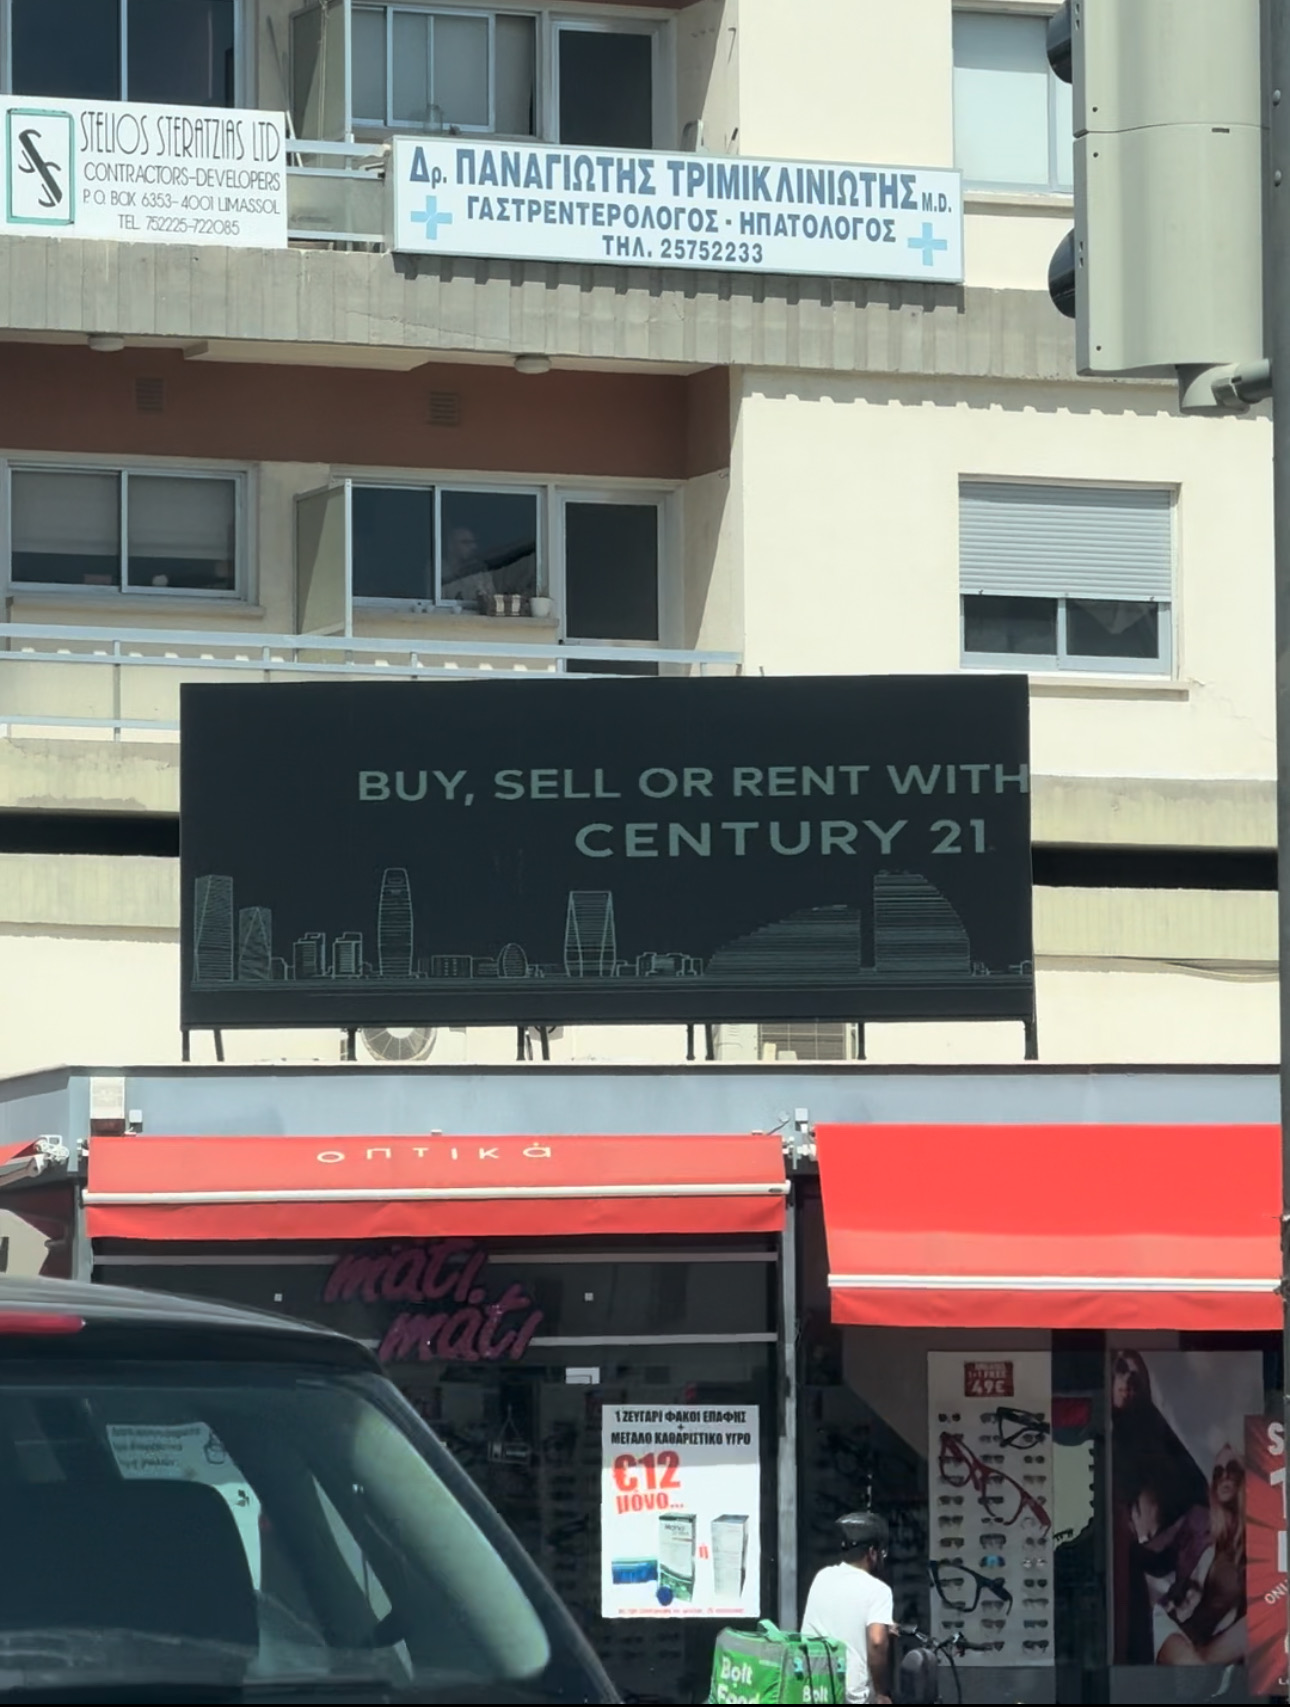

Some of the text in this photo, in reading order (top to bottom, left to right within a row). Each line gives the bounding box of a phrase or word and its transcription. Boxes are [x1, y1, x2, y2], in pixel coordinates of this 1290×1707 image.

[80, 110, 280, 162] STELIOS STERATZIAS LTD
[84, 161, 280, 191] CONTRACTORS-DEVELOPERS
[409, 146, 952, 213] Δρ. ΠΑΝΑΓΙΩΤΗΣ ΤΡΙΜΙΚΛΙΝΙΩΤΗΣ M.D.
[110, 190, 136, 206] BOX
[218, 196, 280, 215] LIMASSOL
[146, 215, 240, 235] 752225-722085
[467, 195, 719, 233] ΓΑΣΤΡΕΝΤΕΡΟΛΟΓΟΣ
[740, 211, 896, 243] ΗΠΑΤΟΛΟΓΟΣ
[602, 234, 763, 263] ΤΗΛ. 25752233
[358, 763, 1029, 806] BUY, SELL OR RENT WITH
[575, 819, 985, 858] CENTURY 21
[622, 1410, 663, 1423] ΖΕΥΓΑΡΙ
[665, 1410, 701, 1423] ΦΑΚΟΙ
[703, 1410, 747, 1423] ΕΠΑΦΗΣ
[611, 1432, 751, 1446] ΜΕΓΑΛΟ ΚΑΘΑΡΙΣΤΙΚΟ ΥΓΡΟ
[612, 1450, 681, 1492] €12
[720, 1655, 753, 1686] Bolt
[802, 1684, 828, 1703] Bolt
